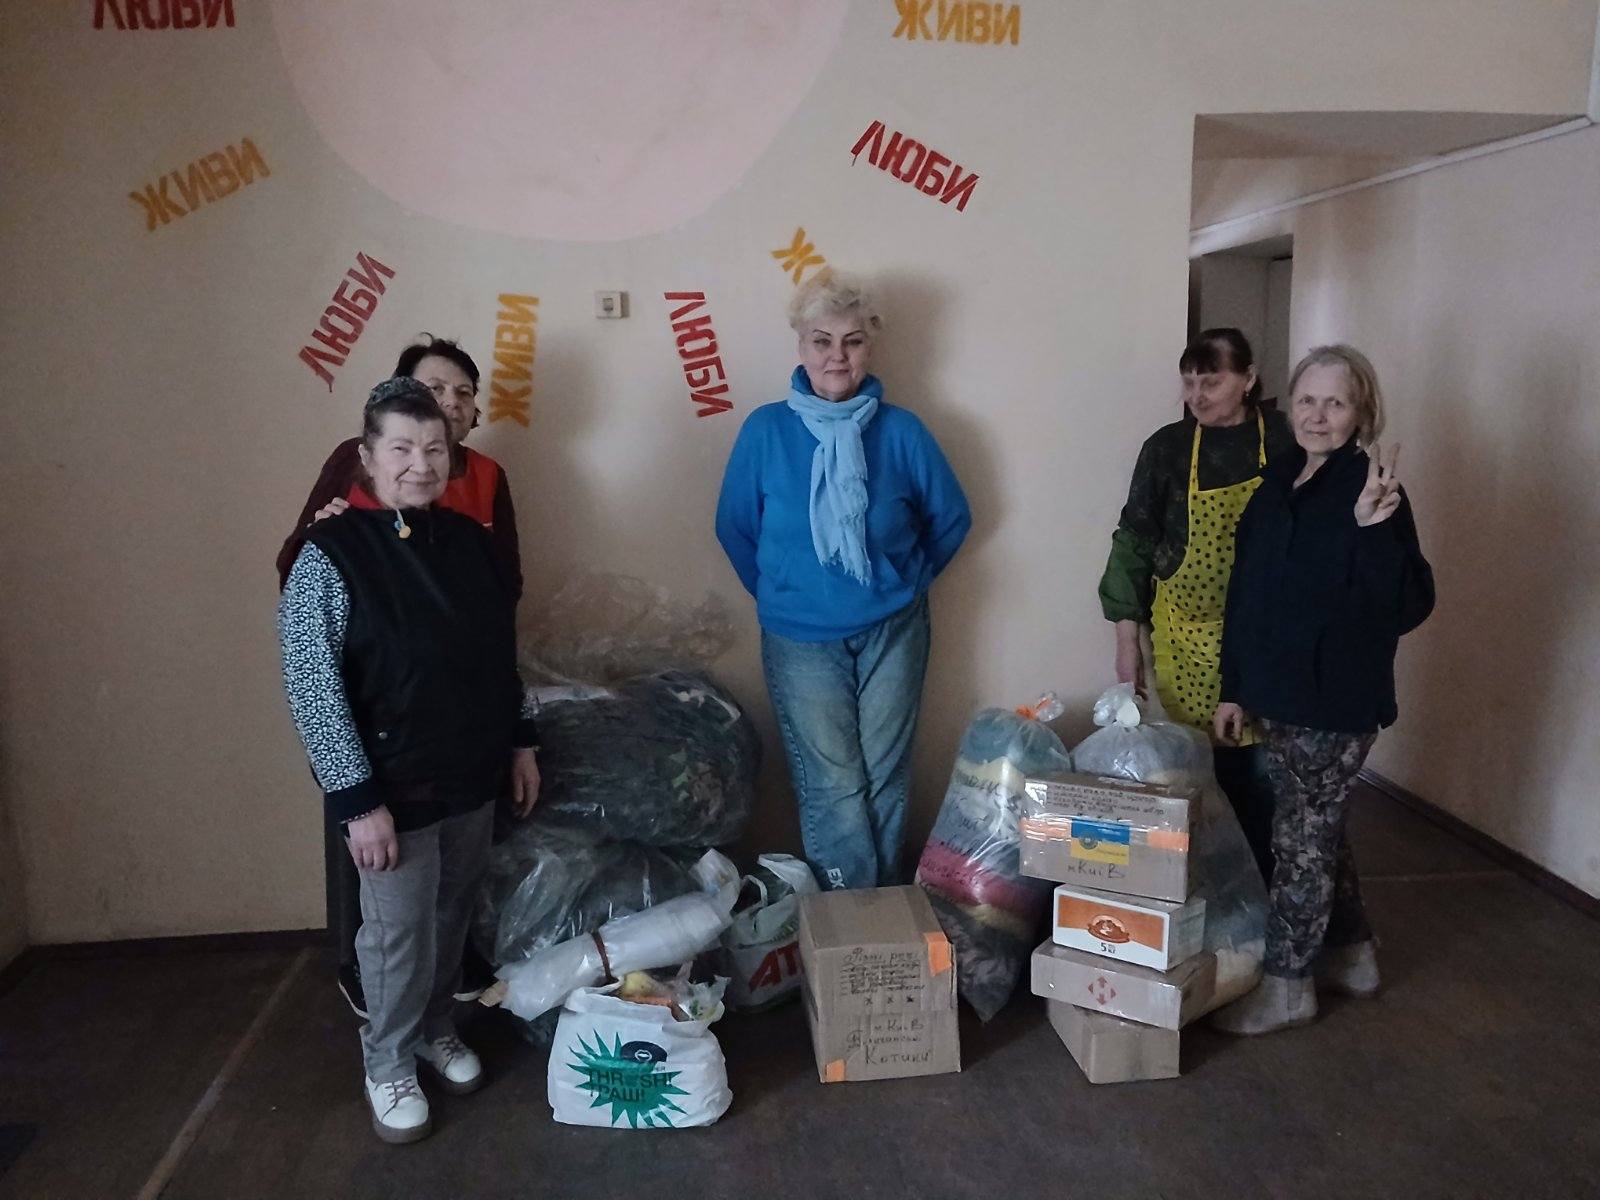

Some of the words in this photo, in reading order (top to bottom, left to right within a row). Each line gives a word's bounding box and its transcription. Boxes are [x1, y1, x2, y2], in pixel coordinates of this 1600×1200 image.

[94, 0, 235, 30] ЛЮБИ
[892, 0, 1021, 46] ЖИВИ
[129, 137, 271, 231] ЖИВИ
[850, 120, 980, 213] ЛЮБИ
[299, 251, 396, 392] ЛЮБИ
[664, 291, 734, 418] ЛЮБИ
[488, 293, 540, 428] ЖИВИ
[750, 940, 800, 991] АТ
[1101, 943, 1107, 951] 5
[587, 1067, 673, 1089] THRSH!
